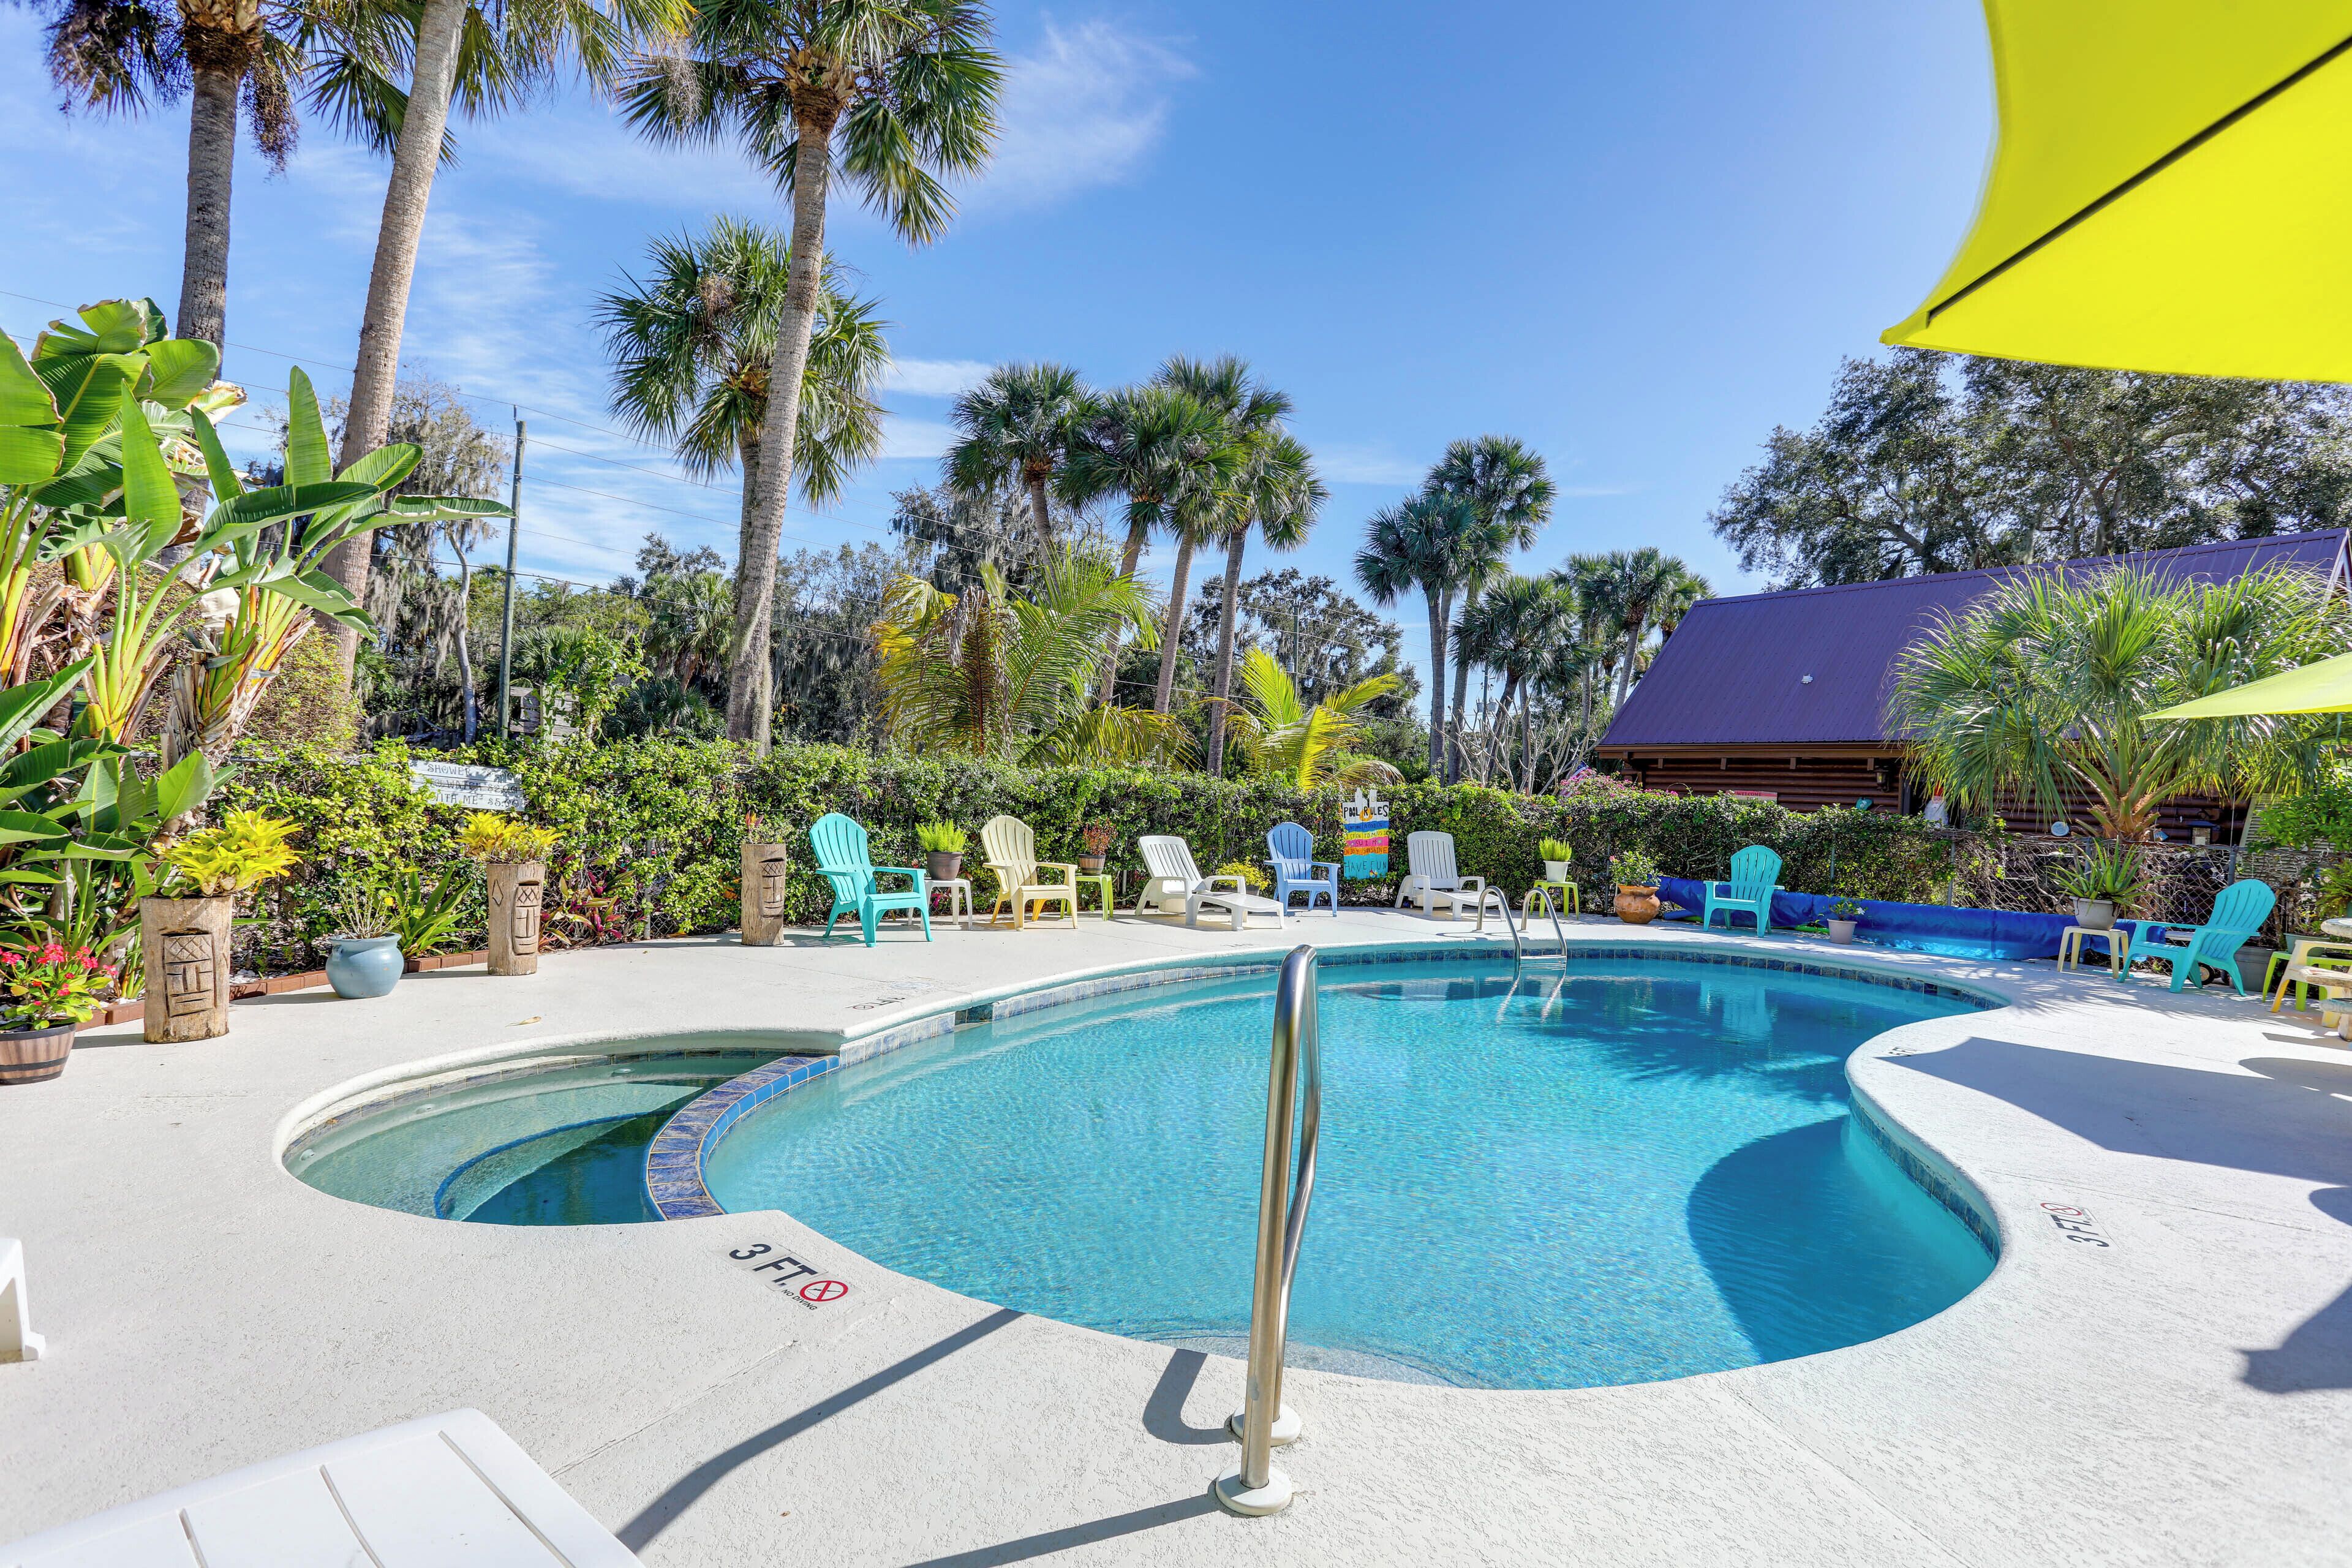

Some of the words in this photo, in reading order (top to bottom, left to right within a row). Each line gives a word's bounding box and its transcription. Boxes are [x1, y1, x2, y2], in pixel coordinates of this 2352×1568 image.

[427, 764, 471, 776] SHOWER
[1344, 806, 1360, 818] POOL
[1363, 804, 1389, 817] RULES
[1344, 861, 1368, 874] HAVE
[1370, 861, 1387, 870] FUN
[2050, 1215, 2100, 1236] FT.
[2066, 1235, 2109, 1247] 3
[729, 1243, 772, 1260] 3
[752, 1256, 819, 1286] FT.
[781, 1289, 794, 1297] NO
[792, 1295, 818, 1311] DIVING
